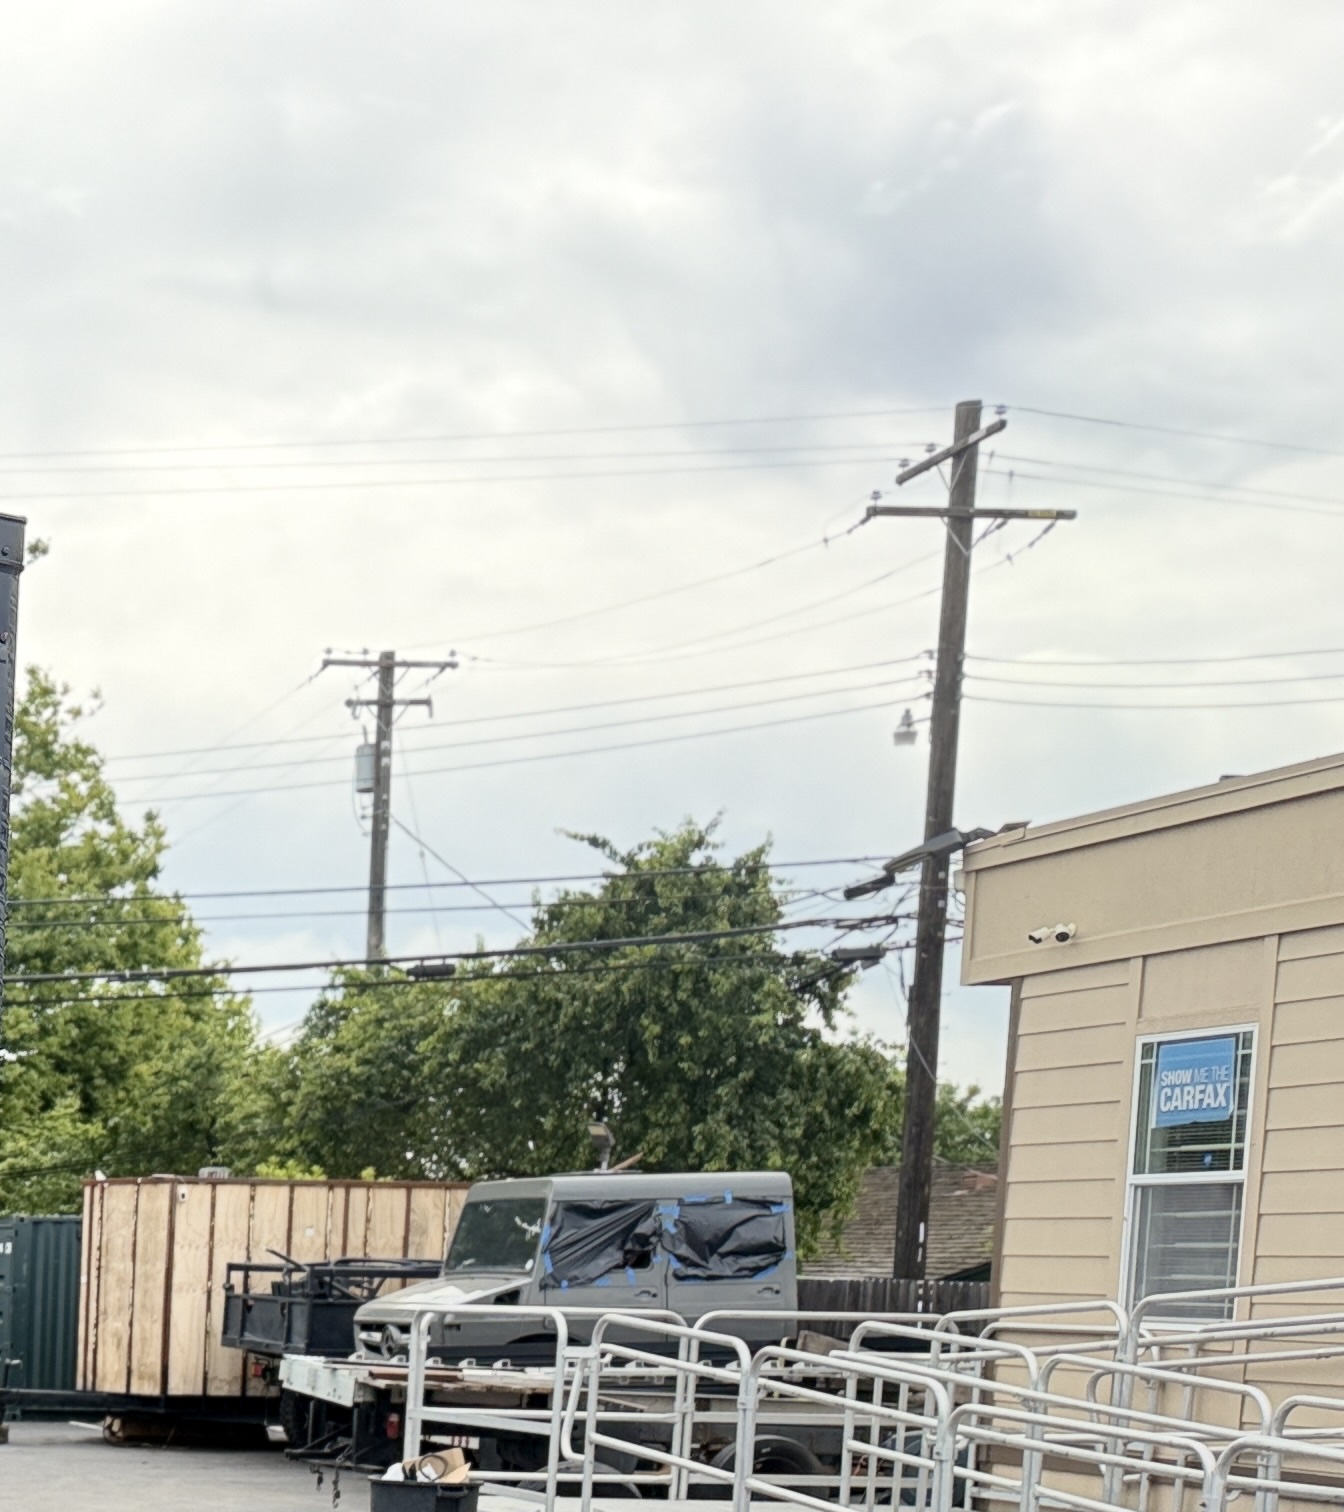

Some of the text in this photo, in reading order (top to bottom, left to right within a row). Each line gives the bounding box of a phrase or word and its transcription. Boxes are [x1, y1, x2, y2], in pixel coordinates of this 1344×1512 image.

[1160, 1065, 1230, 1086] SHOW ME THE
[1160, 1083, 1230, 1112] CARFAX
